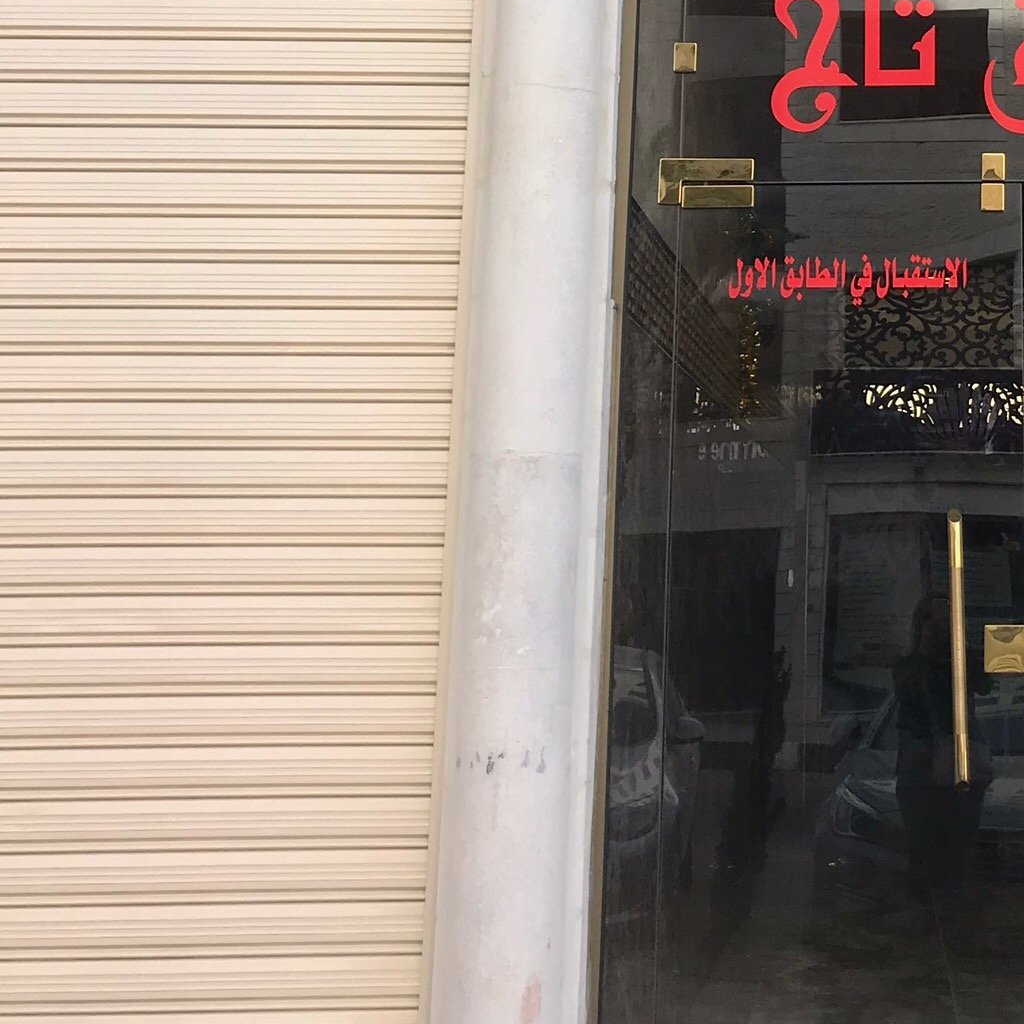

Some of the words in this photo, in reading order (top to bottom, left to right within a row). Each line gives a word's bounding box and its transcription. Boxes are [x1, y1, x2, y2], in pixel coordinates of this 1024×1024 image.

[728, 256, 777, 299] الاول
[780, 256, 847, 300] الطابق
[850, 253, 873, 305] في
[876, 254, 968, 299] الاستقبال
